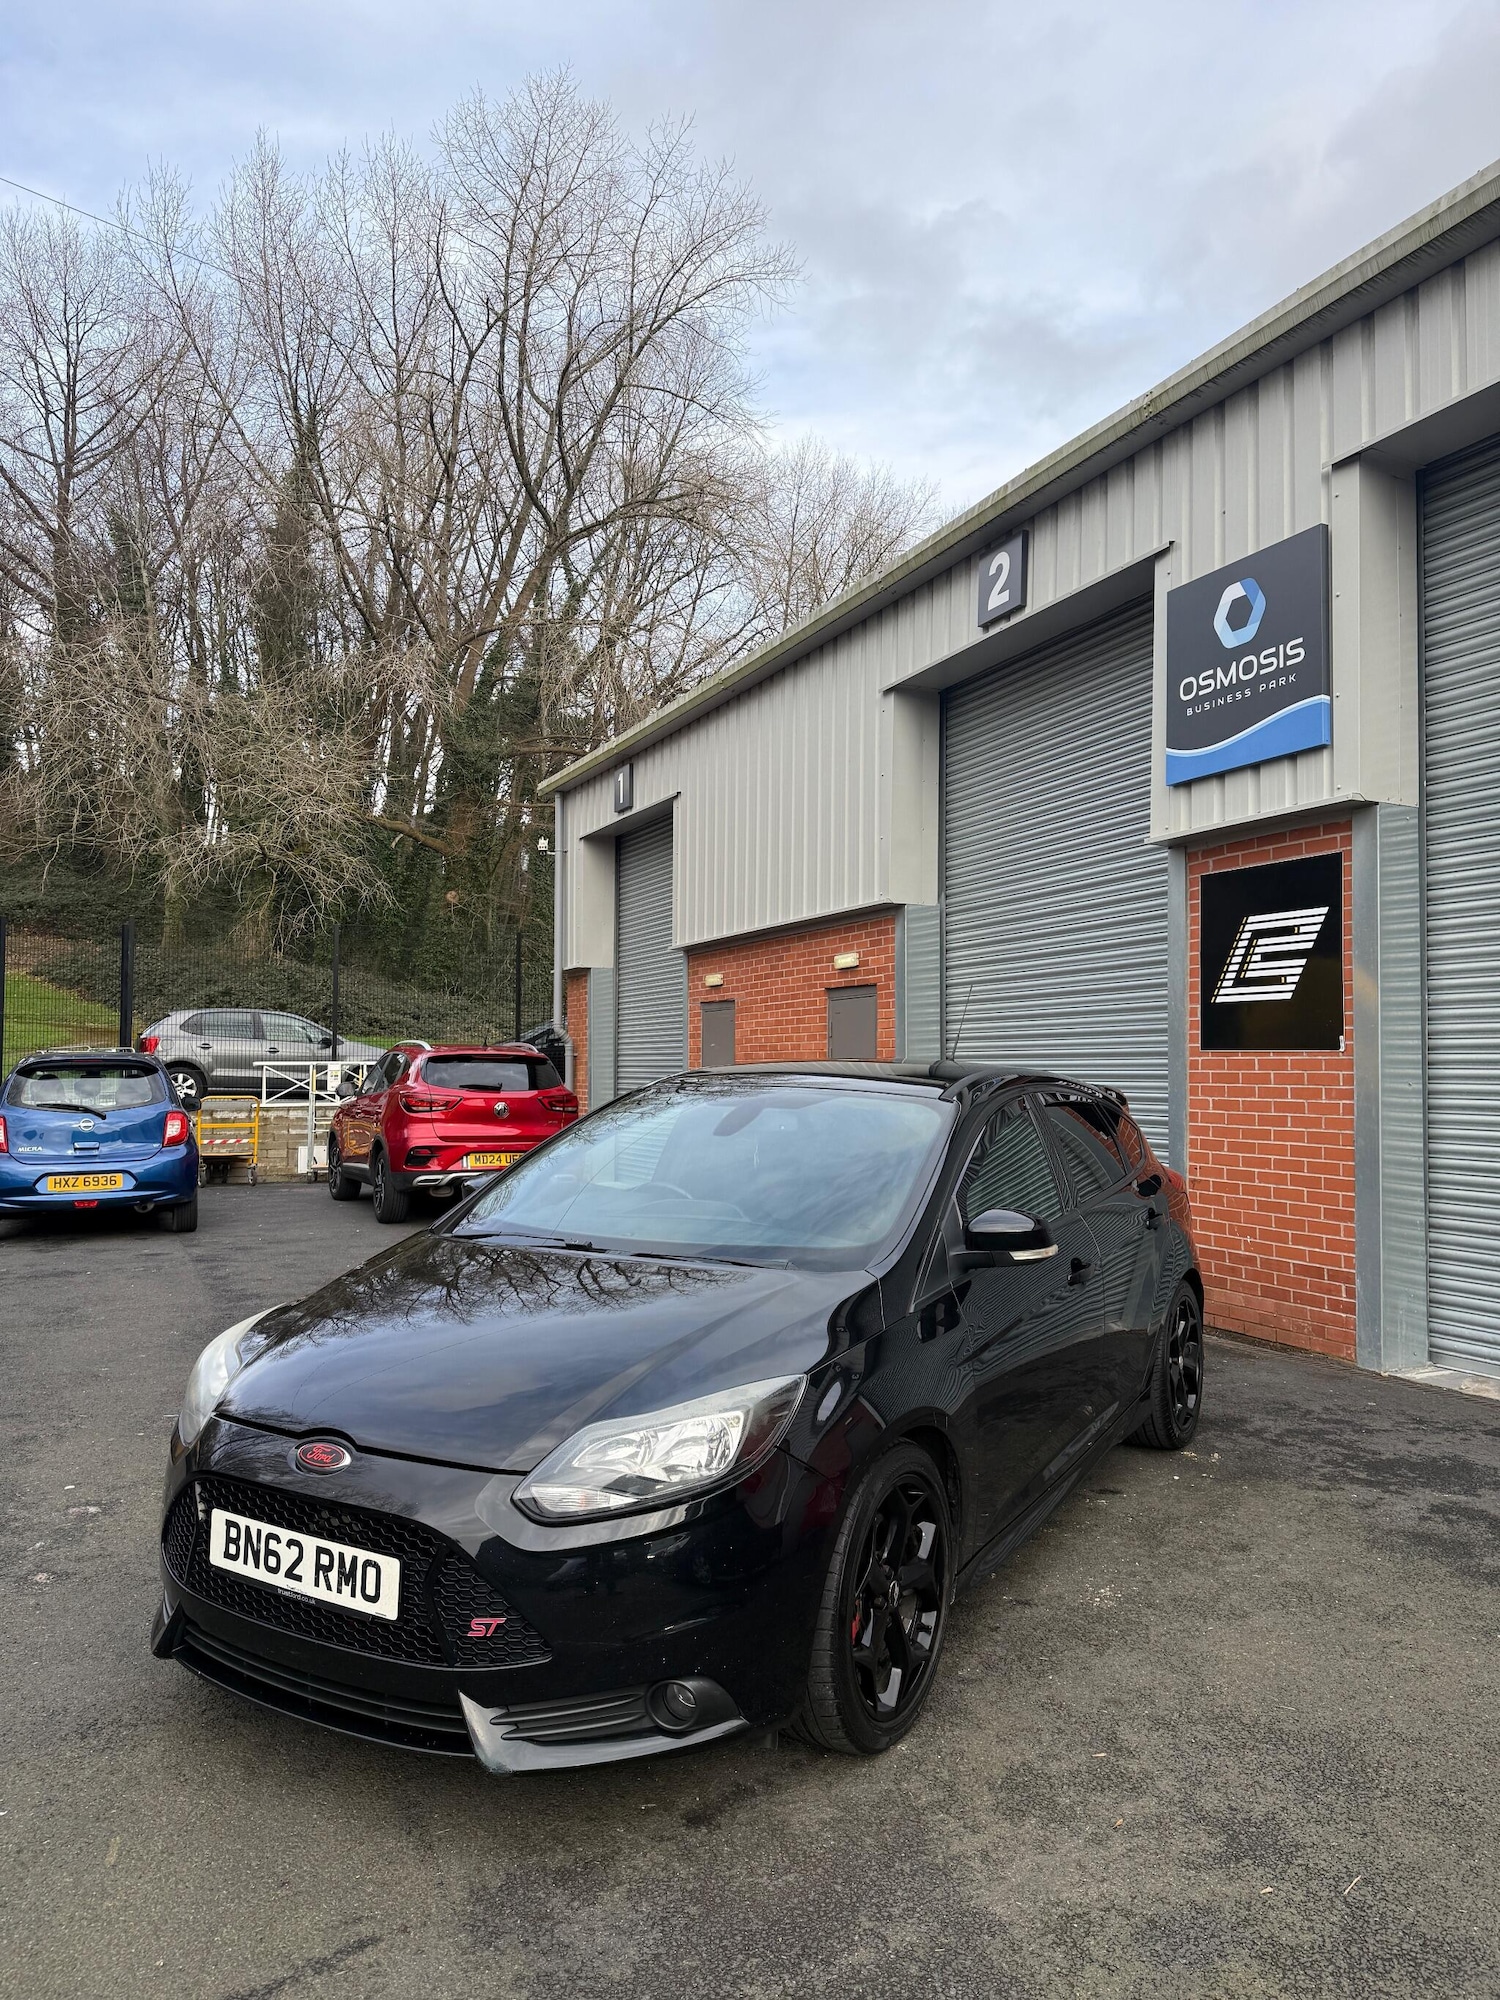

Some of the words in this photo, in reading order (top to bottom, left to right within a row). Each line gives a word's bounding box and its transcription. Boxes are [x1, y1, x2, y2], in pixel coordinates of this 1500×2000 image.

[988, 551, 1010, 611] 2
[1179, 637, 1306, 701] OSMOSIS
[1186, 688, 1252, 716] BUSINESS
[1259, 673, 1297, 693] PARK
[617, 772, 624, 804] 1
[474, 1154, 502, 1165] MD24
[53, 1177, 79, 1189] HXZ
[83, 1175, 117, 1187] 6936
[306, 1445, 336, 1463] Ford
[223, 1518, 304, 1583] BN62
[314, 1545, 382, 1604] RMO
[467, 1617, 507, 1637] ST
